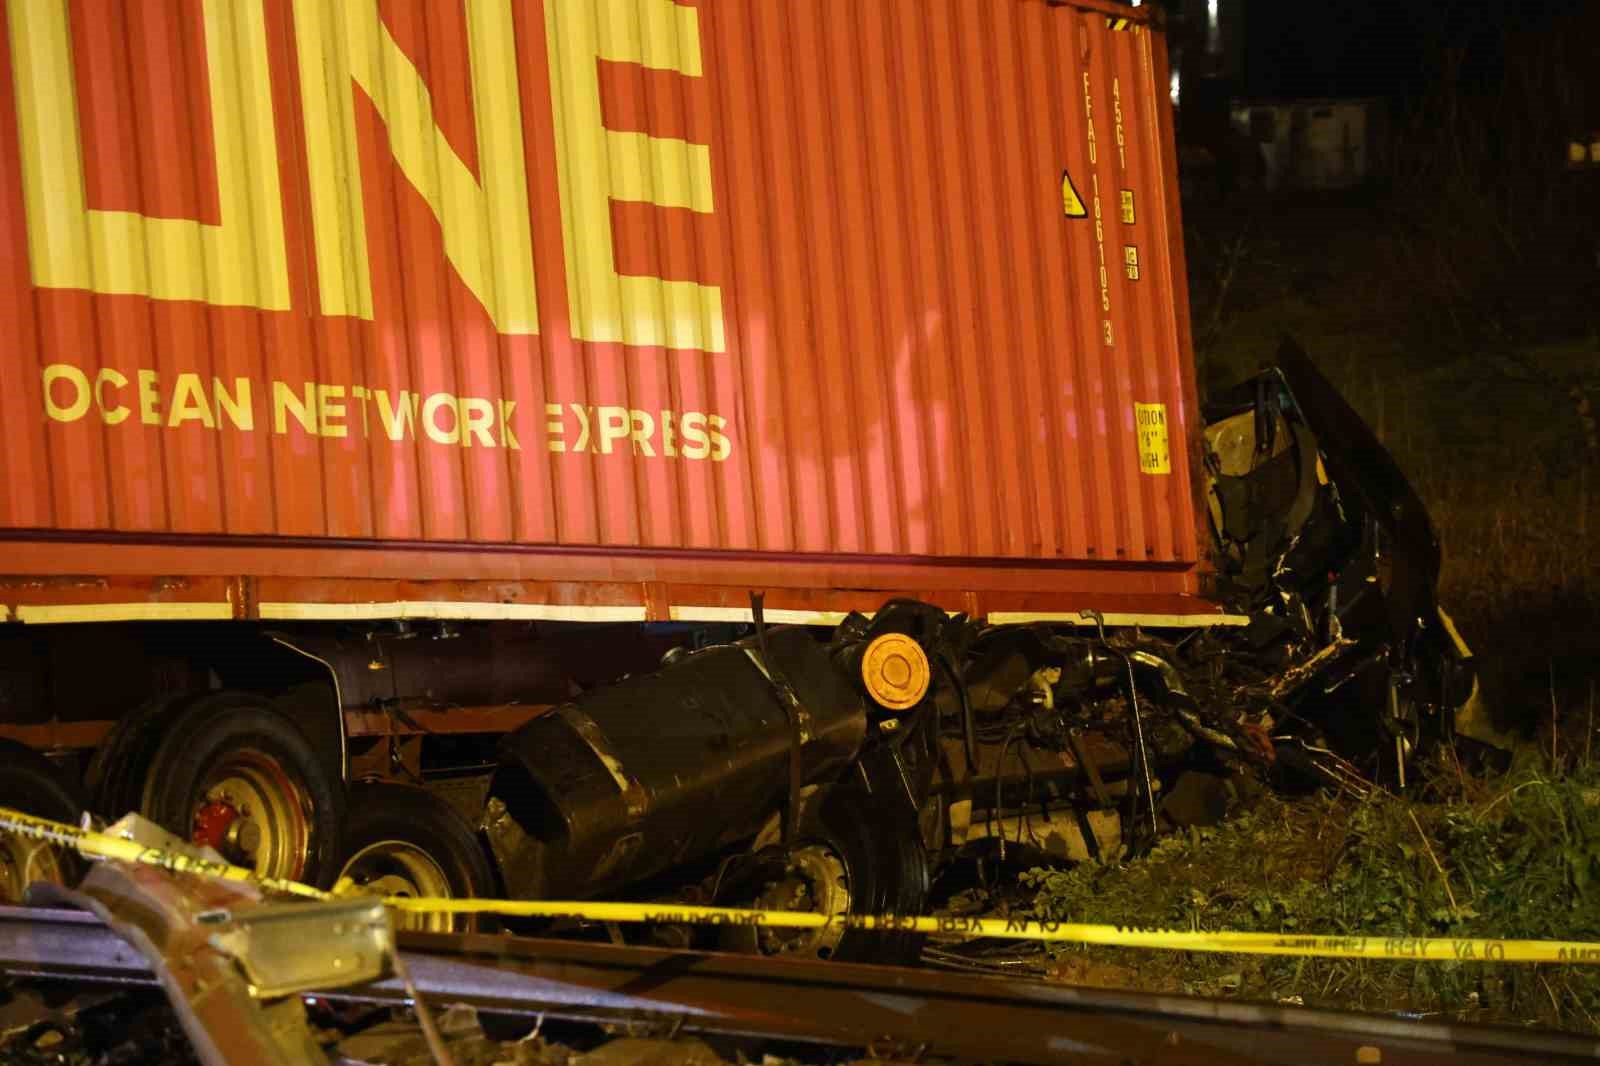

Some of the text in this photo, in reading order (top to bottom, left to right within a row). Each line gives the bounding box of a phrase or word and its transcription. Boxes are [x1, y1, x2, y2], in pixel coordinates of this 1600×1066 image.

[1083, 71, 1097, 164] FFAU
[1103, 319, 1112, 346] 3
[43, 363, 731, 462] OCEAN NETWORK EXPRESS
[1137, 408, 1164, 425] UTION
